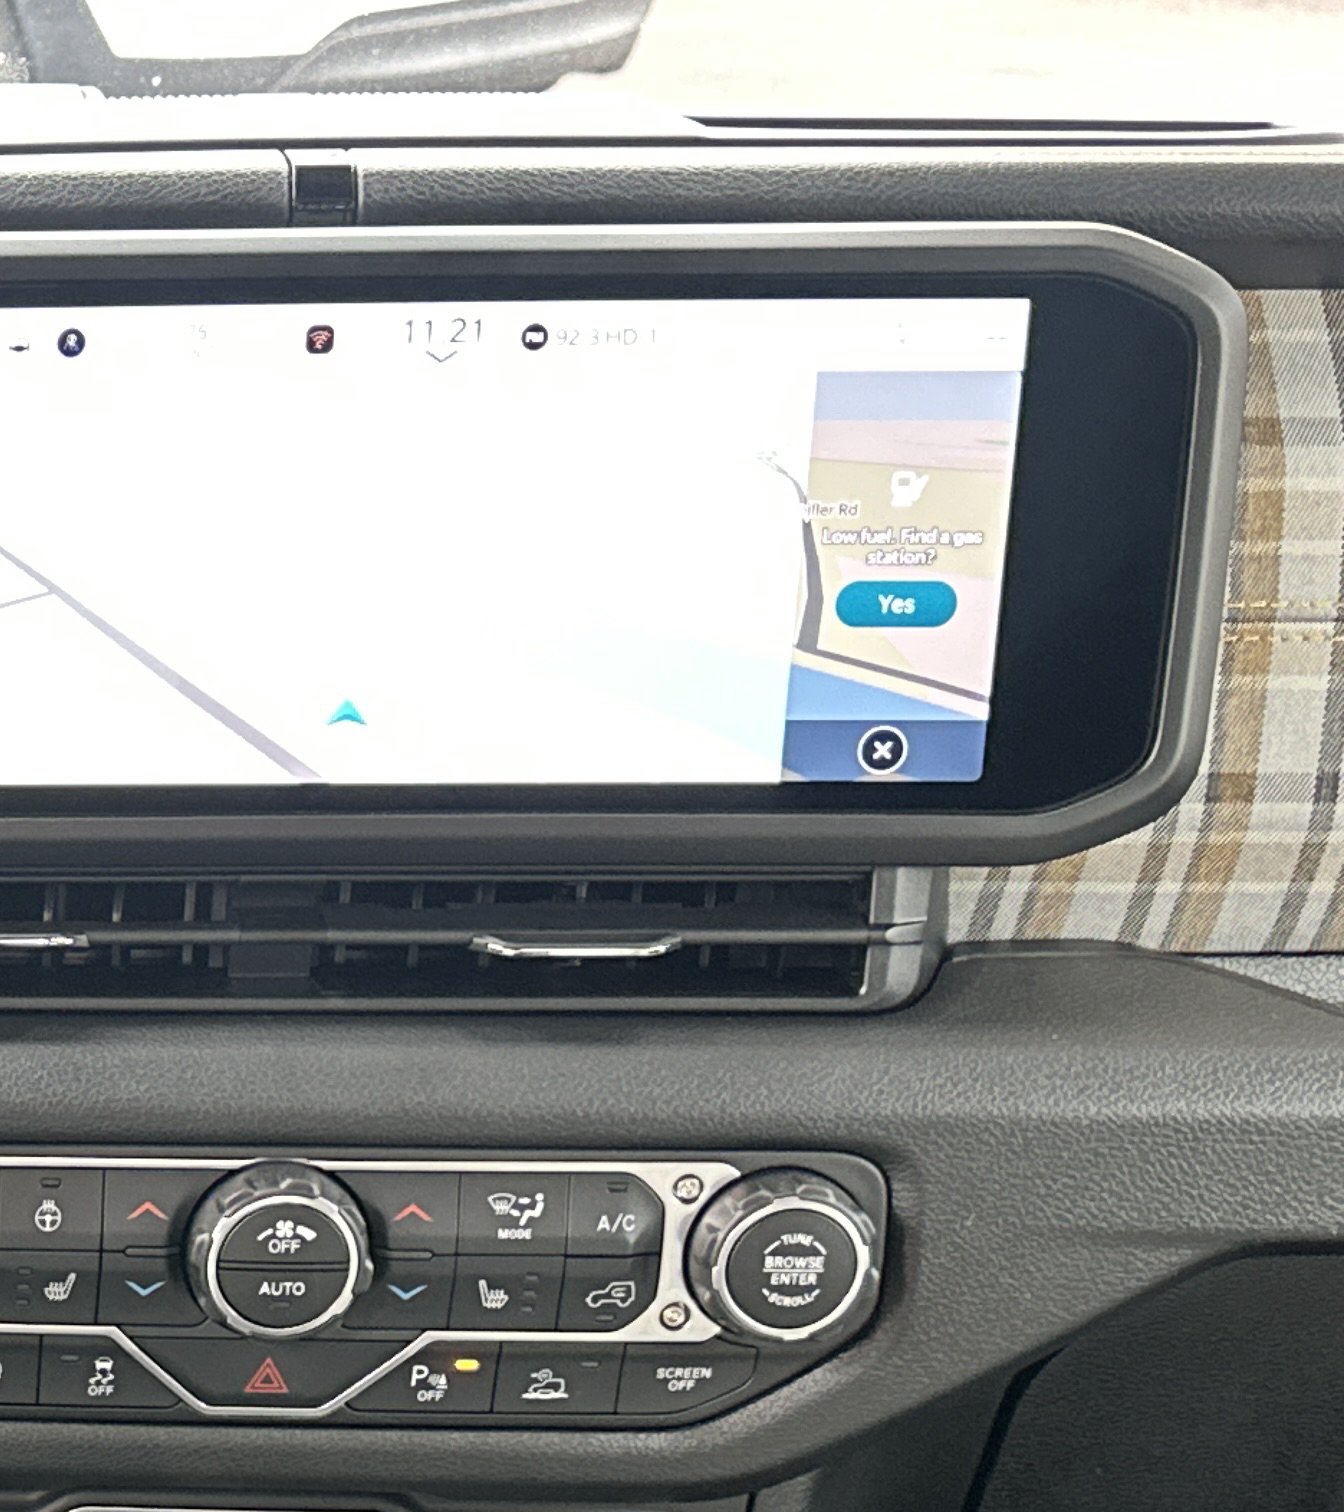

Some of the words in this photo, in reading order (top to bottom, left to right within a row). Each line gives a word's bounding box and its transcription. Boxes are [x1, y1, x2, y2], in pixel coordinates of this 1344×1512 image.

[555, 328, 600, 346] 923
[838, 503, 858, 516] Rd
[821, 527, 858, 545] Low
[899, 527, 938, 545] Find
[939, 532, 950, 545] a
[952, 531, 984, 548] gas
[865, 549, 938, 566] station?
[878, 594, 916, 615] Yes
[596, 1212, 636, 1234] A/C
[497, 1228, 533, 1240] MODE
[780, 1232, 814, 1247] TUNE
[267, 1239, 302, 1255] OFF
[764, 1255, 825, 1269] BROWSE
[770, 1272, 818, 1286] ENTER
[258, 1280, 307, 1298] AUTO
[767, 1292, 815, 1307] SCROLL
[655, 1367, 712, 1380] SCREEN
[87, 1384, 116, 1397] OFF
[666, 1379, 697, 1392] OFF
[416, 1389, 446, 1402] OFF
